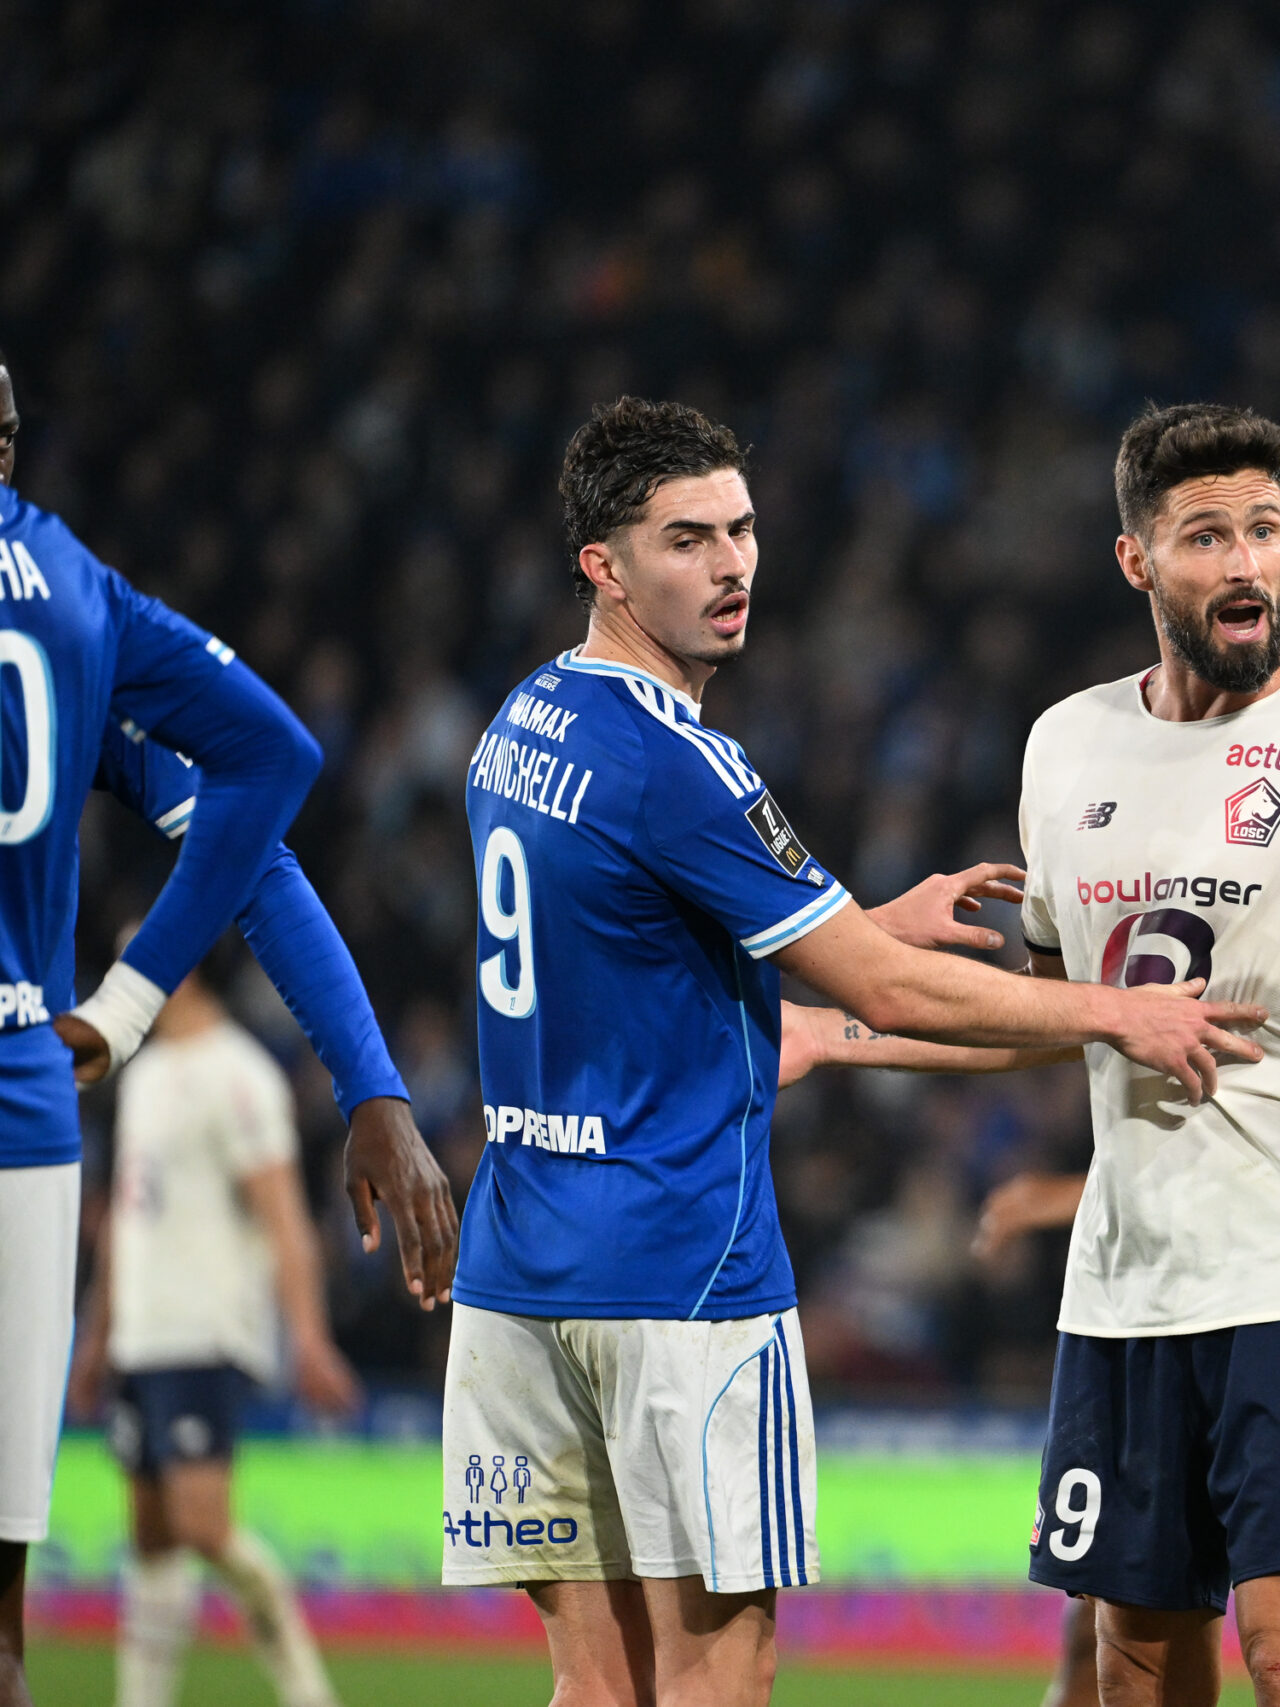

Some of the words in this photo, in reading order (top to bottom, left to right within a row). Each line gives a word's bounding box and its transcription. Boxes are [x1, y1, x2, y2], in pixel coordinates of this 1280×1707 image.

[1233, 826, 1265, 840] LOSC
[1077, 872, 1262, 907] boulanger
[479, 826, 537, 1019] 9
[1049, 1467, 1102, 1562] 9
